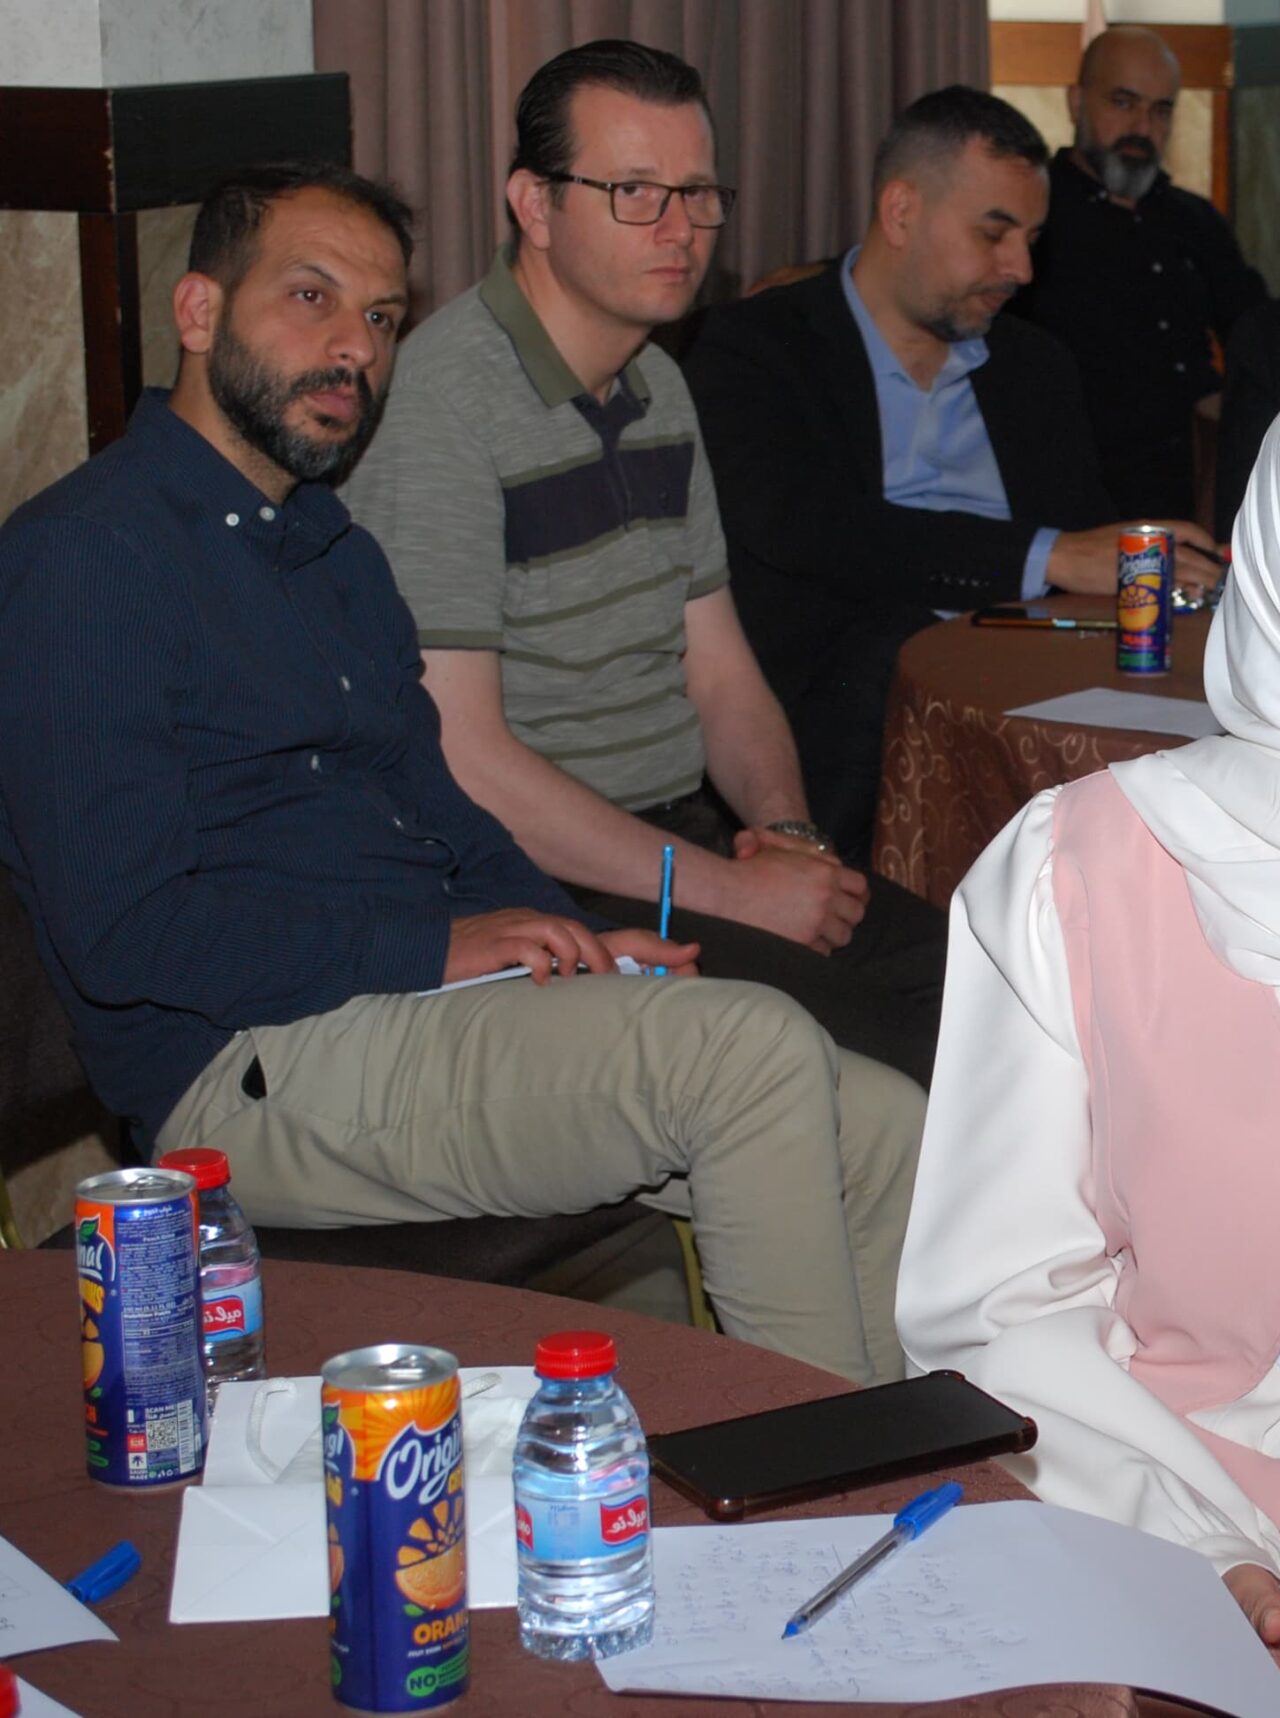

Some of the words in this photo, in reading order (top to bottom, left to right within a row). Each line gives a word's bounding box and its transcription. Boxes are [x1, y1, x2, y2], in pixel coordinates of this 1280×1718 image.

[202, 1306, 242, 1324] ميلان
[413, 1609, 468, 1645] ORAN
[410, 1676, 436, 1691] NO
